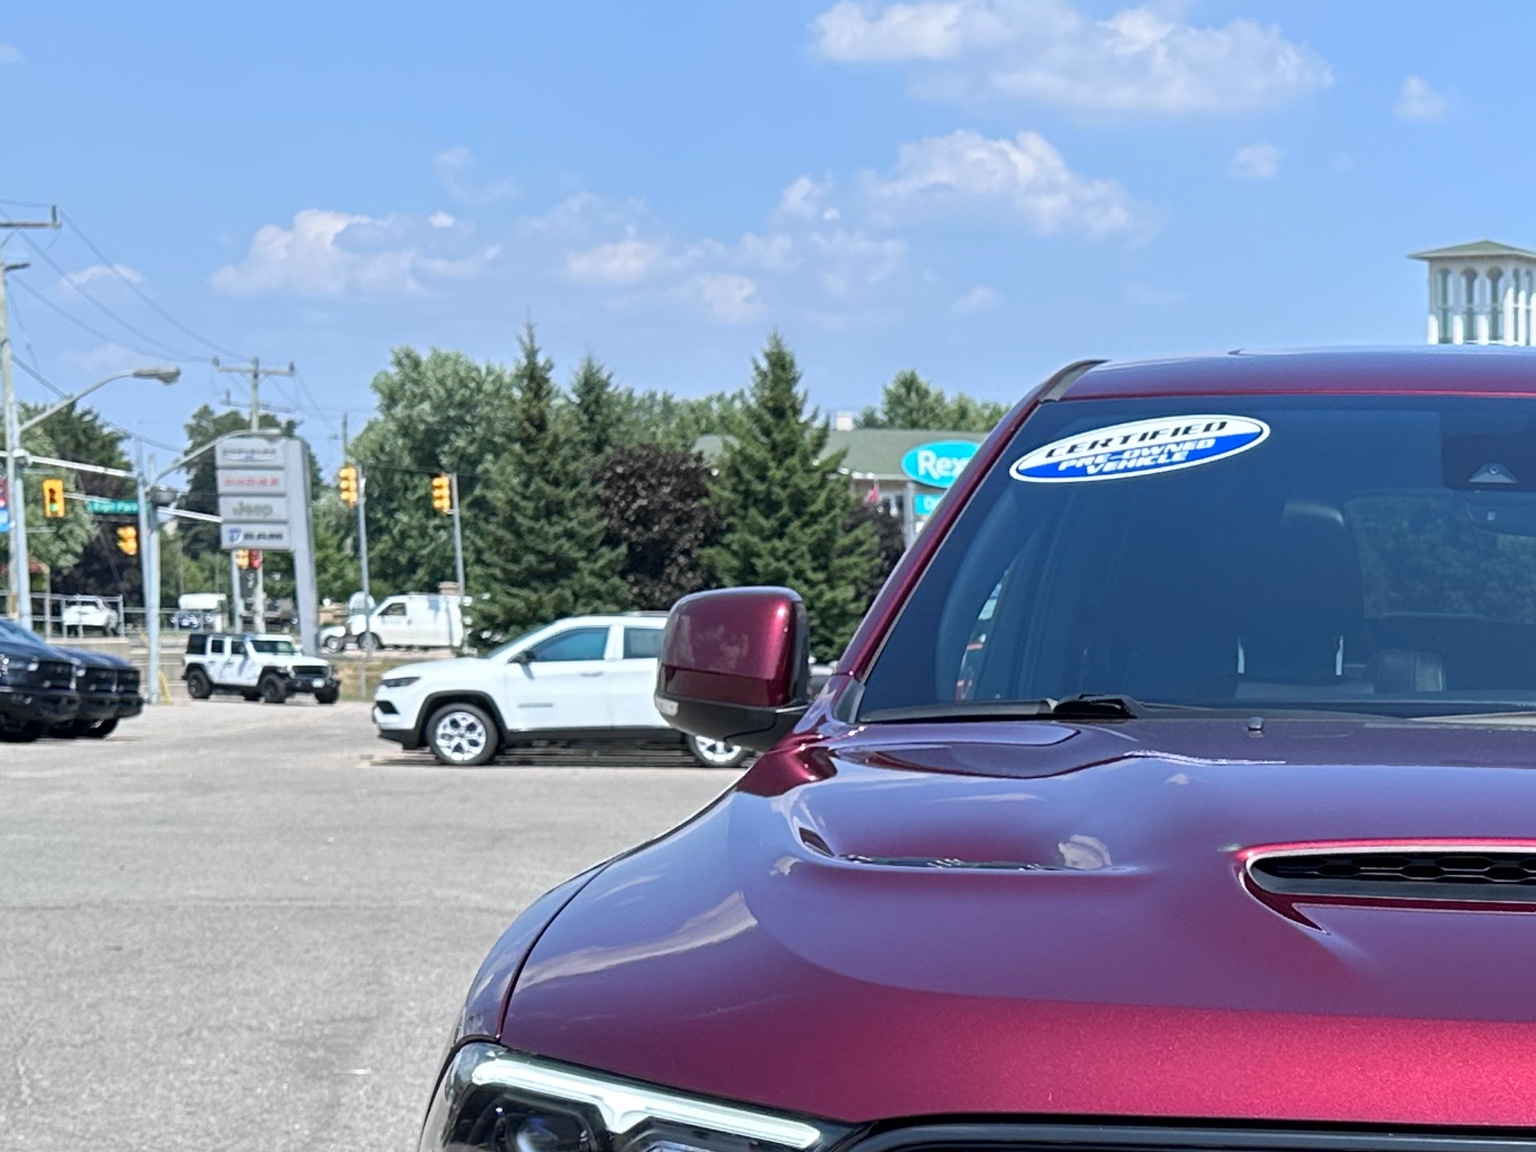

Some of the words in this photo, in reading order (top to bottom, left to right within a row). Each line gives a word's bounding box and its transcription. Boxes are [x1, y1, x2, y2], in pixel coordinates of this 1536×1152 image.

[1045, 421, 1228, 459] CERTIFIED
[1058, 438, 1217, 472] PRE-OWNED
[1087, 451, 1190, 475] VEHICLE
